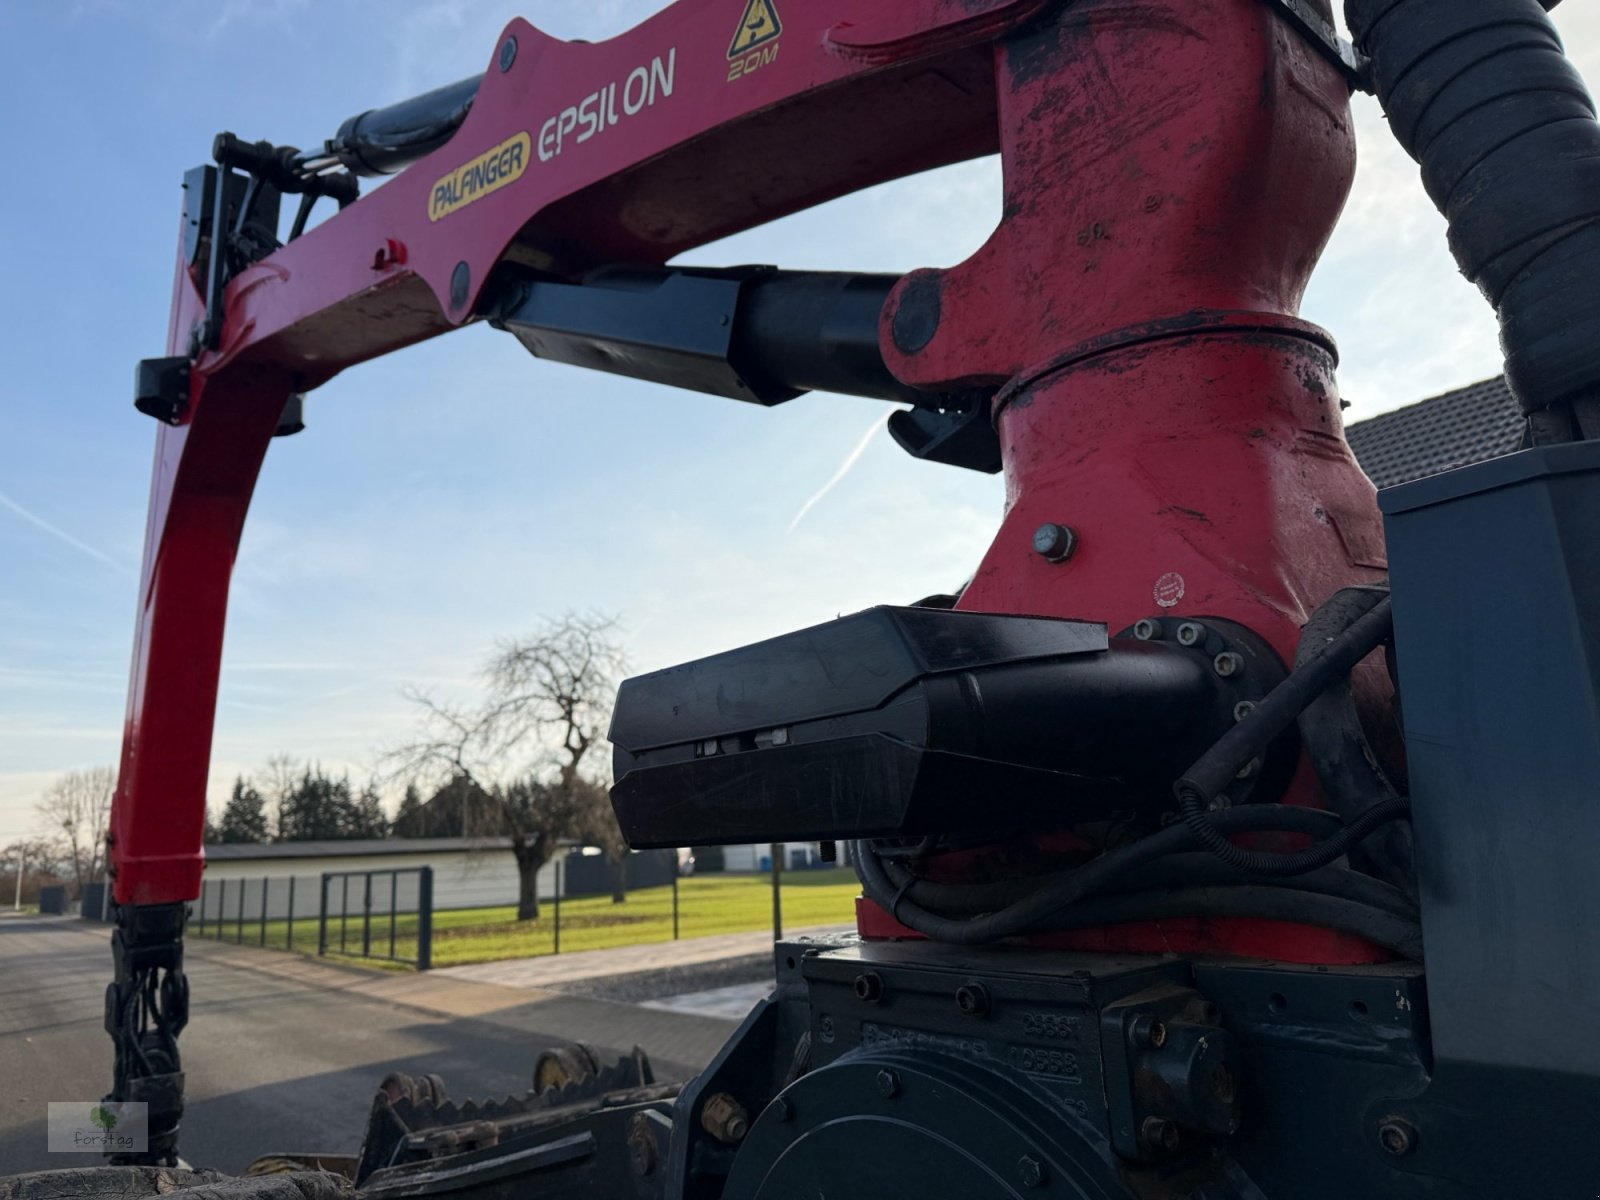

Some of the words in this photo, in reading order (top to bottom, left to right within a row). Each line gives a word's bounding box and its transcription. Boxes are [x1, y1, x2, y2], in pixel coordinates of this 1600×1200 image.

[727, 43, 779, 82] 20M
[431, 140, 525, 215] PALFINGER
[537, 47, 676, 162] EPSILON
